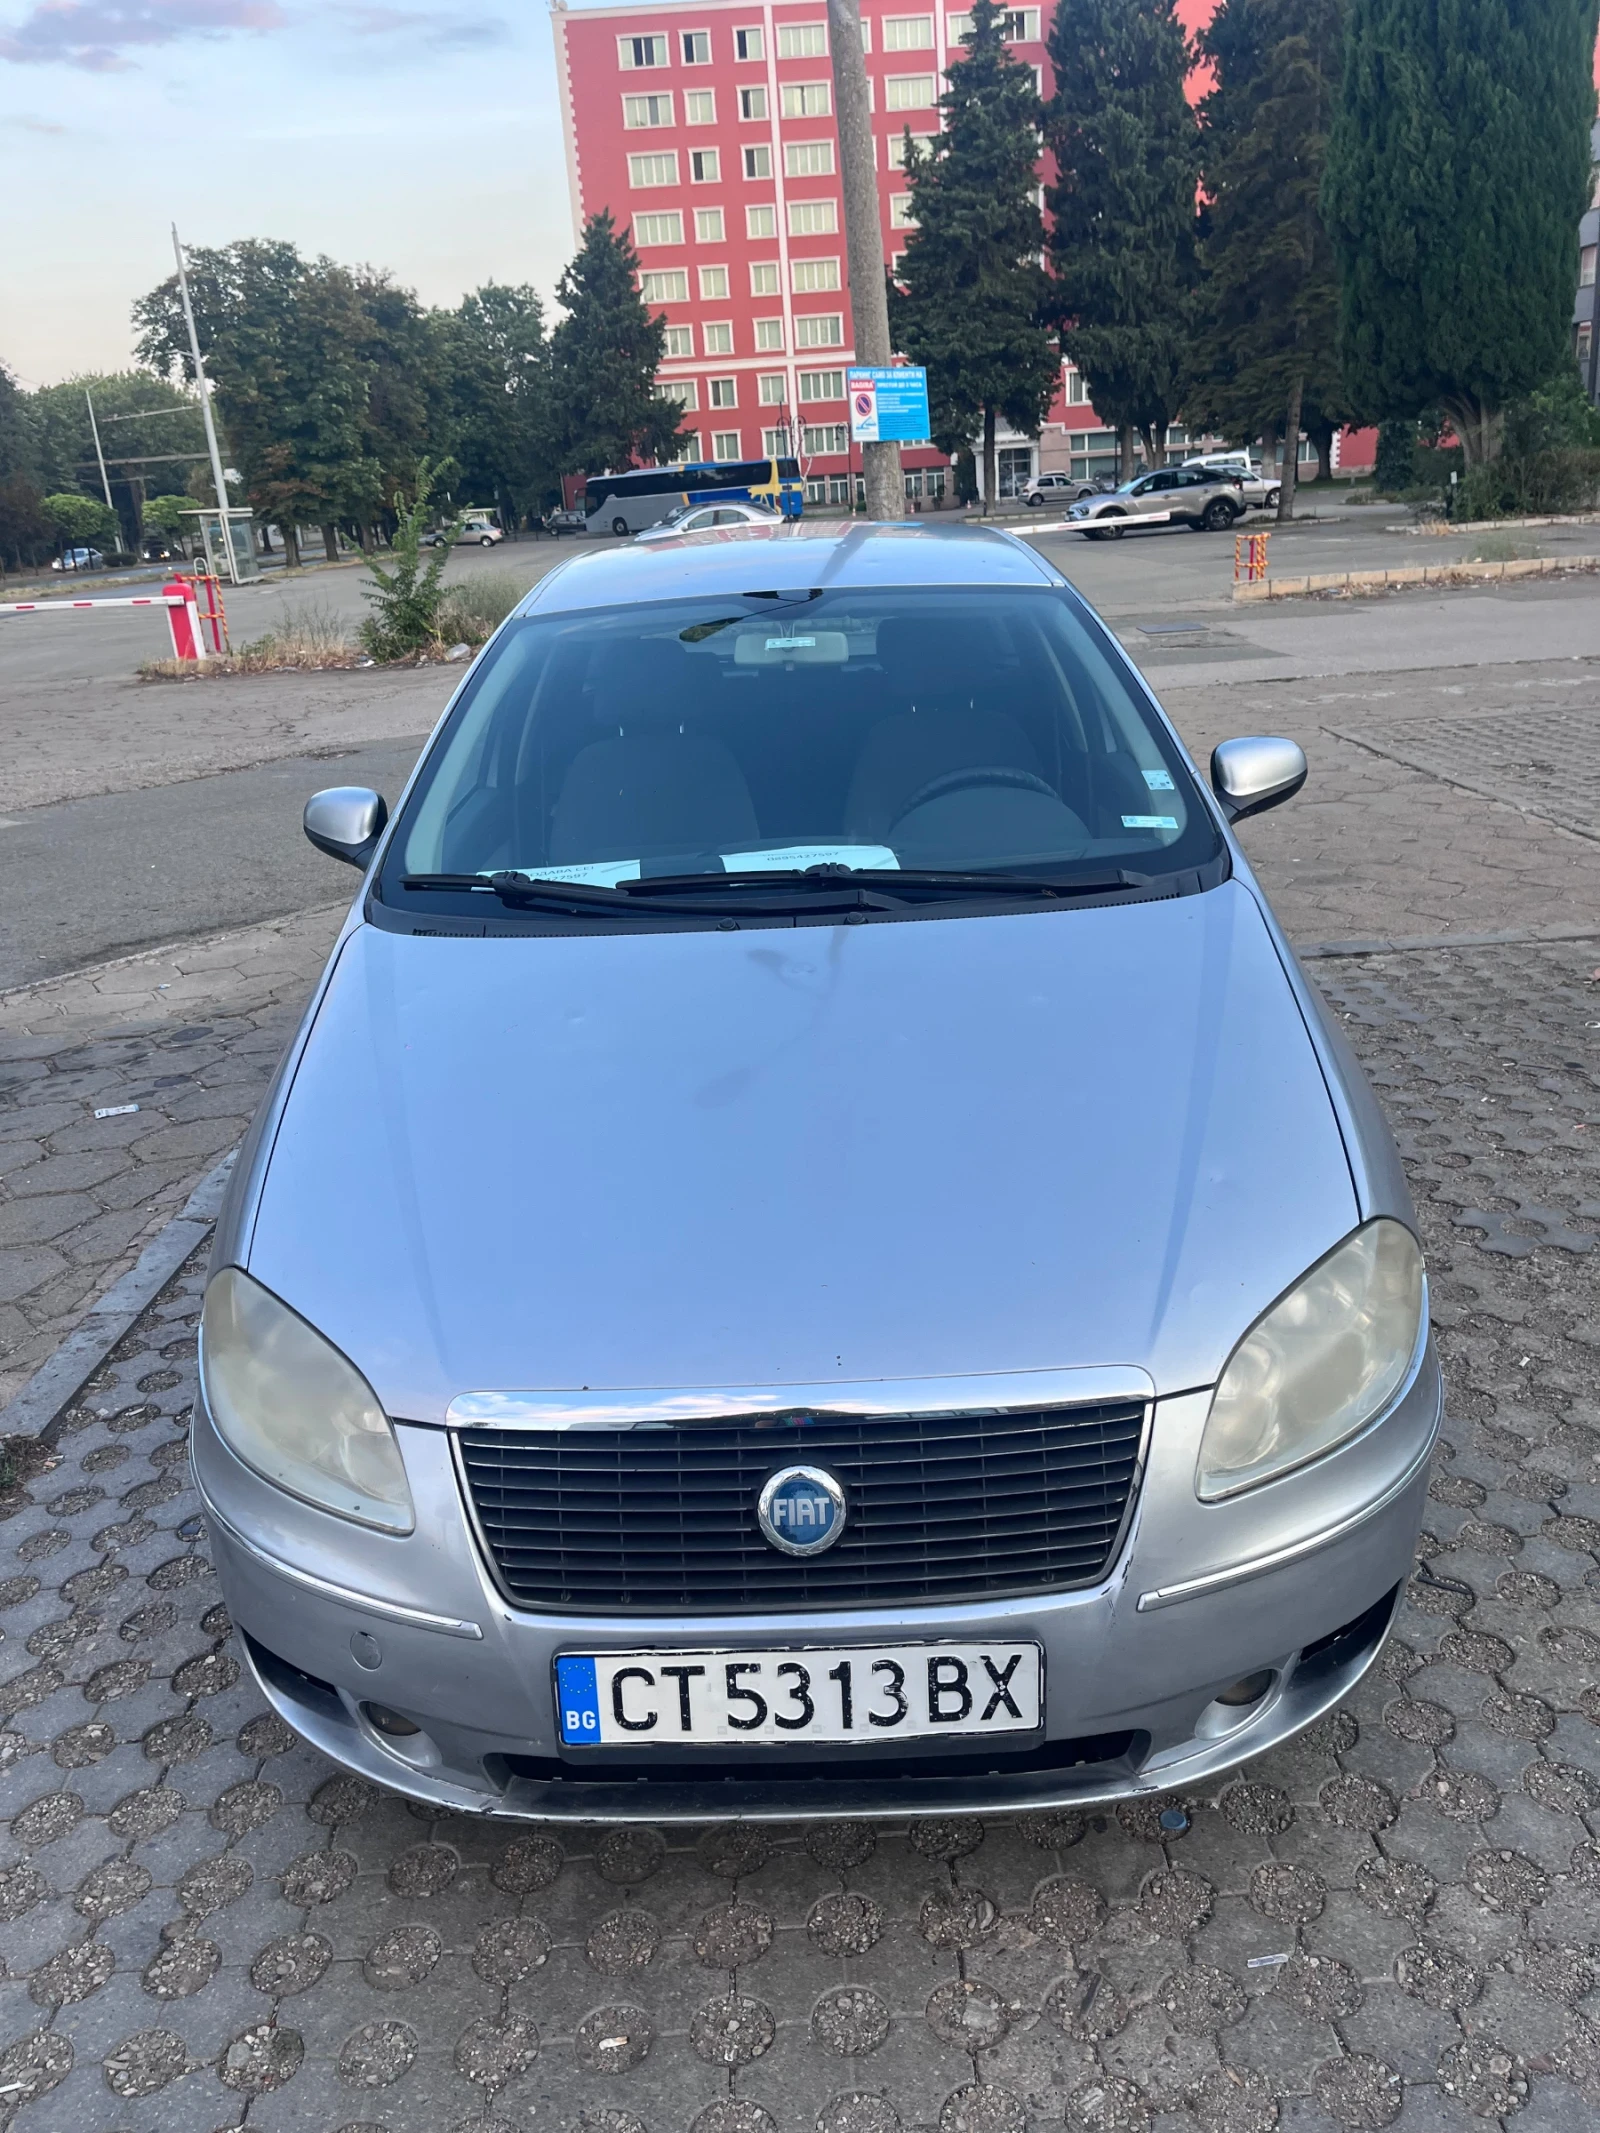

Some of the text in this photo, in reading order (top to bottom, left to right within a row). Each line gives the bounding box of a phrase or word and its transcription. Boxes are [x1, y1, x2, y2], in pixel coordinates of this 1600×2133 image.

[849, 371, 871, 379] ПАРКИНГ
[872, 371, 885, 379] САМО
[886, 371, 893, 379] ЗА
[893, 371, 915, 379] КЛИЕНТИ
[528, 868, 572, 877] ОДАВА
[773, 1497, 829, 1527] FIAT
[566, 1710, 596, 1730] BG
